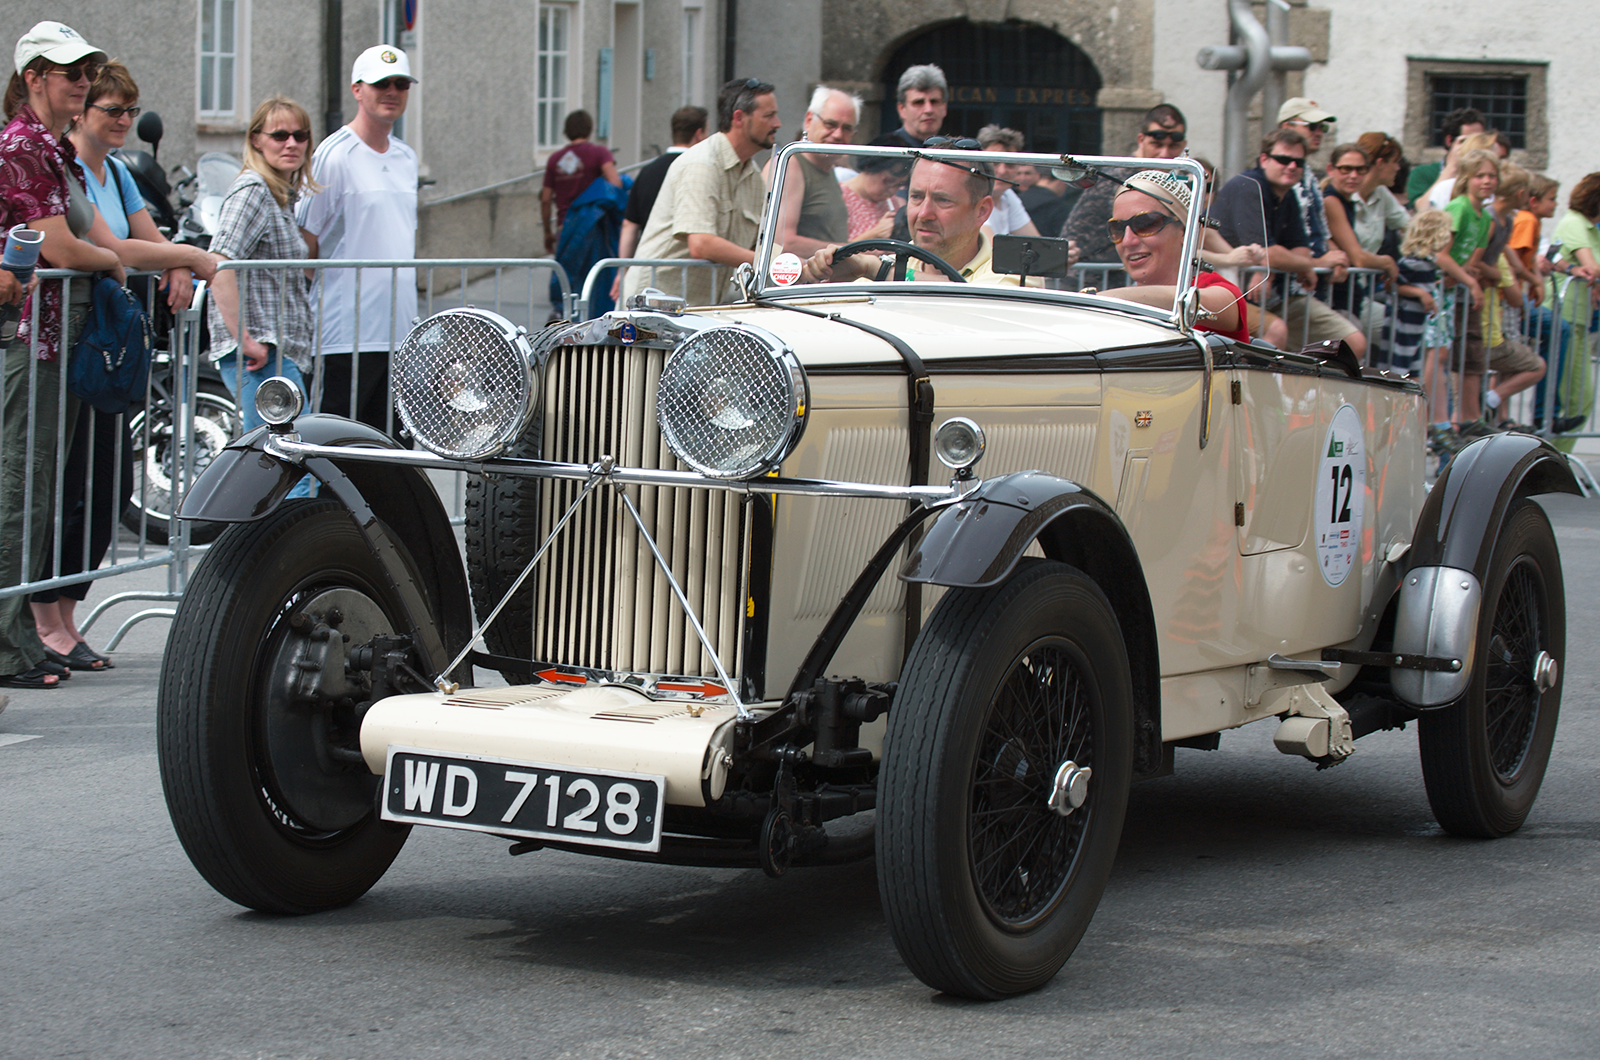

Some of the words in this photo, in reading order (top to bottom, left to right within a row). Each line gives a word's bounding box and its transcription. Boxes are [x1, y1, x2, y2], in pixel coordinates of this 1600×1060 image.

[1331, 464, 1353, 523] 12
[404, 759, 478, 817] WD
[500, 770, 641, 835] 7128
